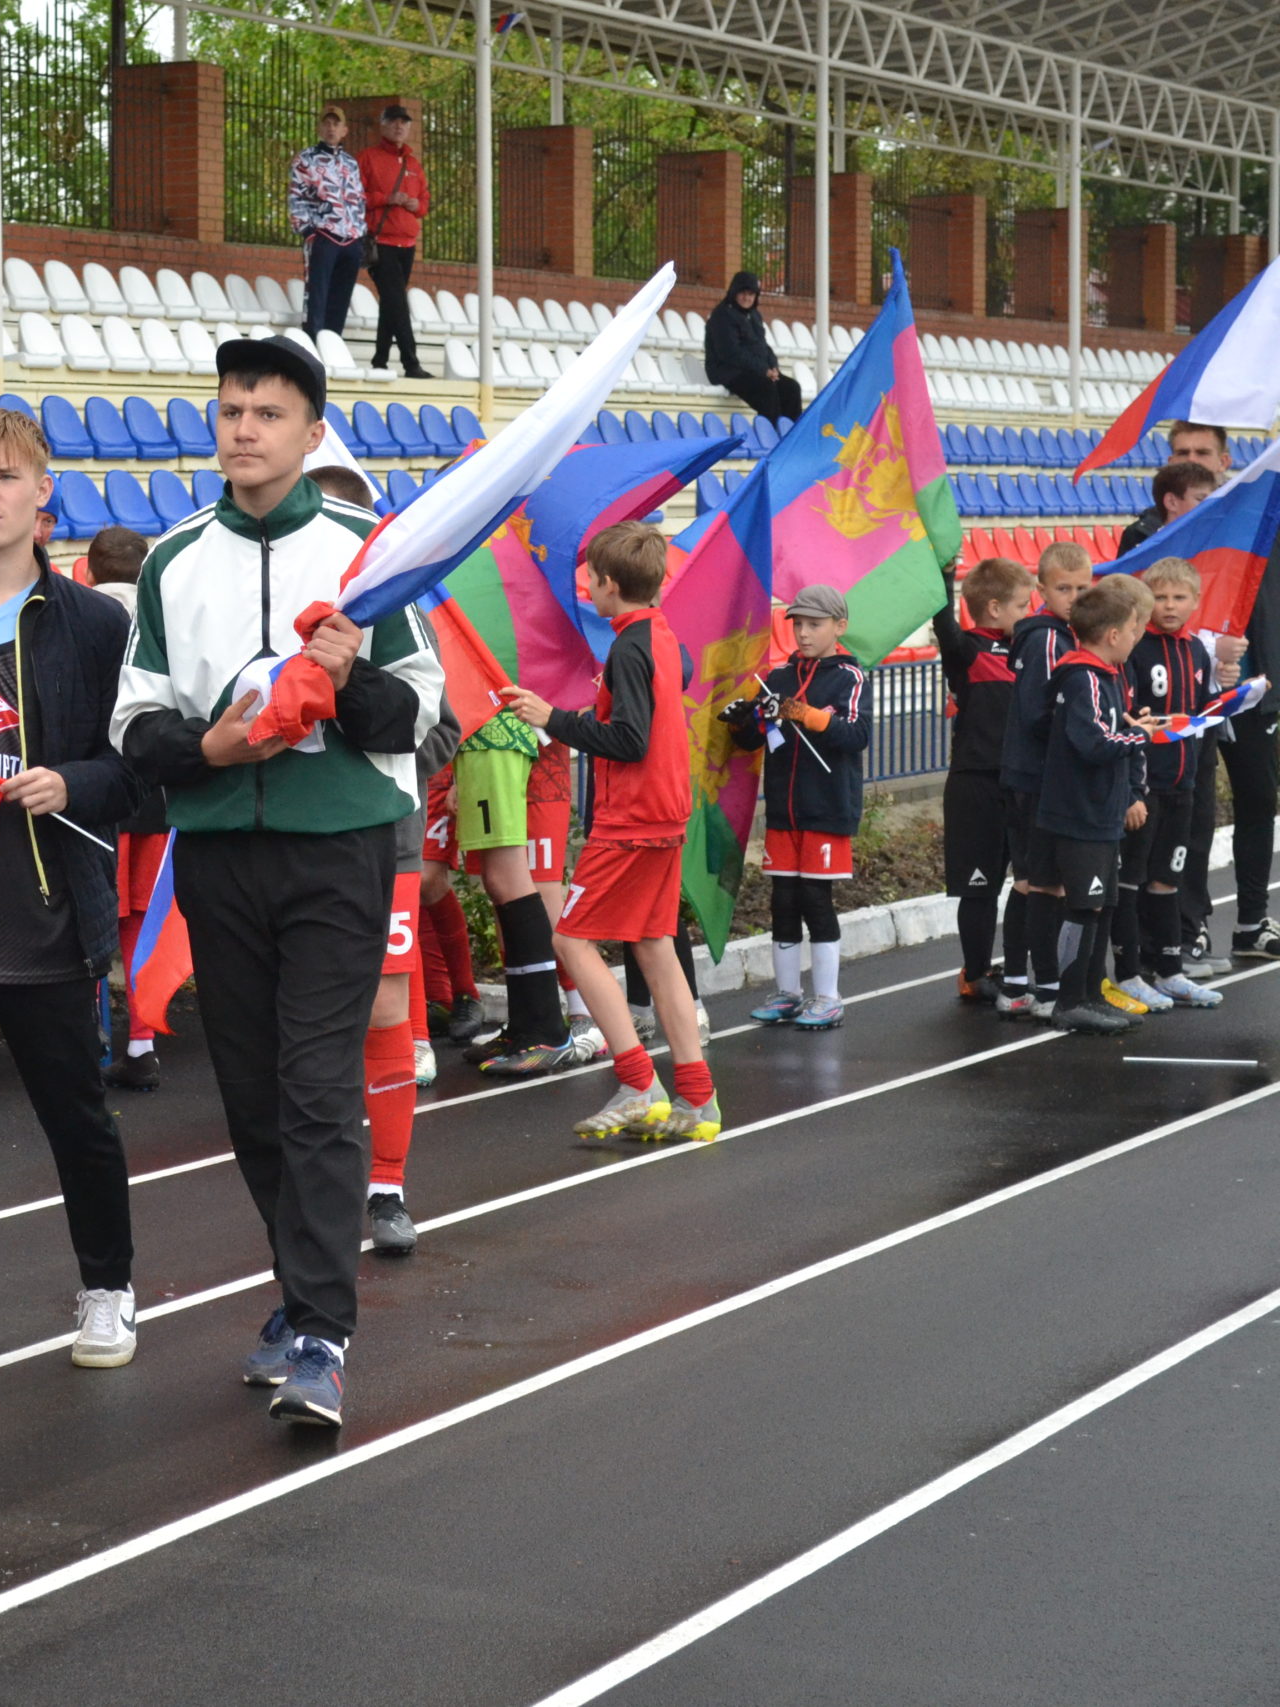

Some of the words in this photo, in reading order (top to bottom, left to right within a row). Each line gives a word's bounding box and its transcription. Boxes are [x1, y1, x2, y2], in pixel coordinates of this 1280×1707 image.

[1150, 664, 1168, 697] 8
[426, 816, 449, 848] 4
[477, 799, 491, 834] 1
[527, 838, 552, 870] 11
[820, 843, 832, 868] 1
[1170, 845, 1187, 872] 8
[387, 911, 413, 955] 5
